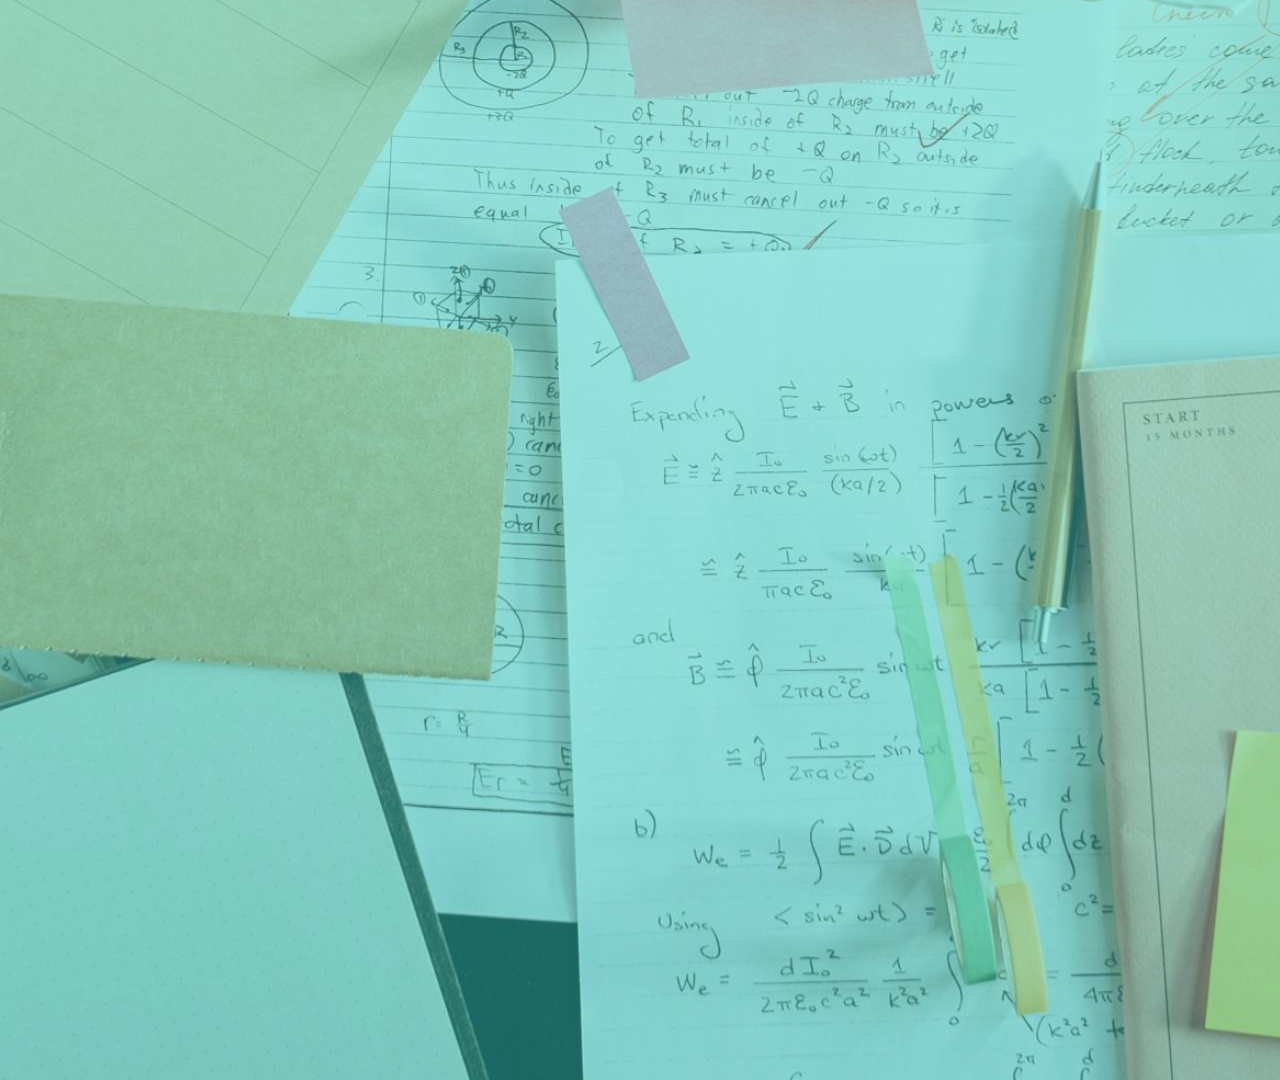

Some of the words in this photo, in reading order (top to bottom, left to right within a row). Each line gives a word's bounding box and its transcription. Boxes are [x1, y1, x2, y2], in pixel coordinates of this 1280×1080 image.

[594, 126, 615, 144] To
[634, 131, 666, 154] get
[688, 134, 728, 149] total
[750, 137, 768, 155] of
[841, 148, 860, 162] on
[917, 147, 978, 165] outside
[689, 189, 736, 204] must
[744, 192, 797, 210] cancel
[819, 196, 848, 209] out
[631, 395, 744, 442] Expanding
[888, 395, 906, 415] in
[932, 392, 1014, 420] powers
[1142, 409, 1200, 425] START
[1146, 432, 1161, 442] 15
[1169, 425, 1236, 440] MONTHS
[633, 619, 674, 645] and
[658, 916, 721, 960] Using
